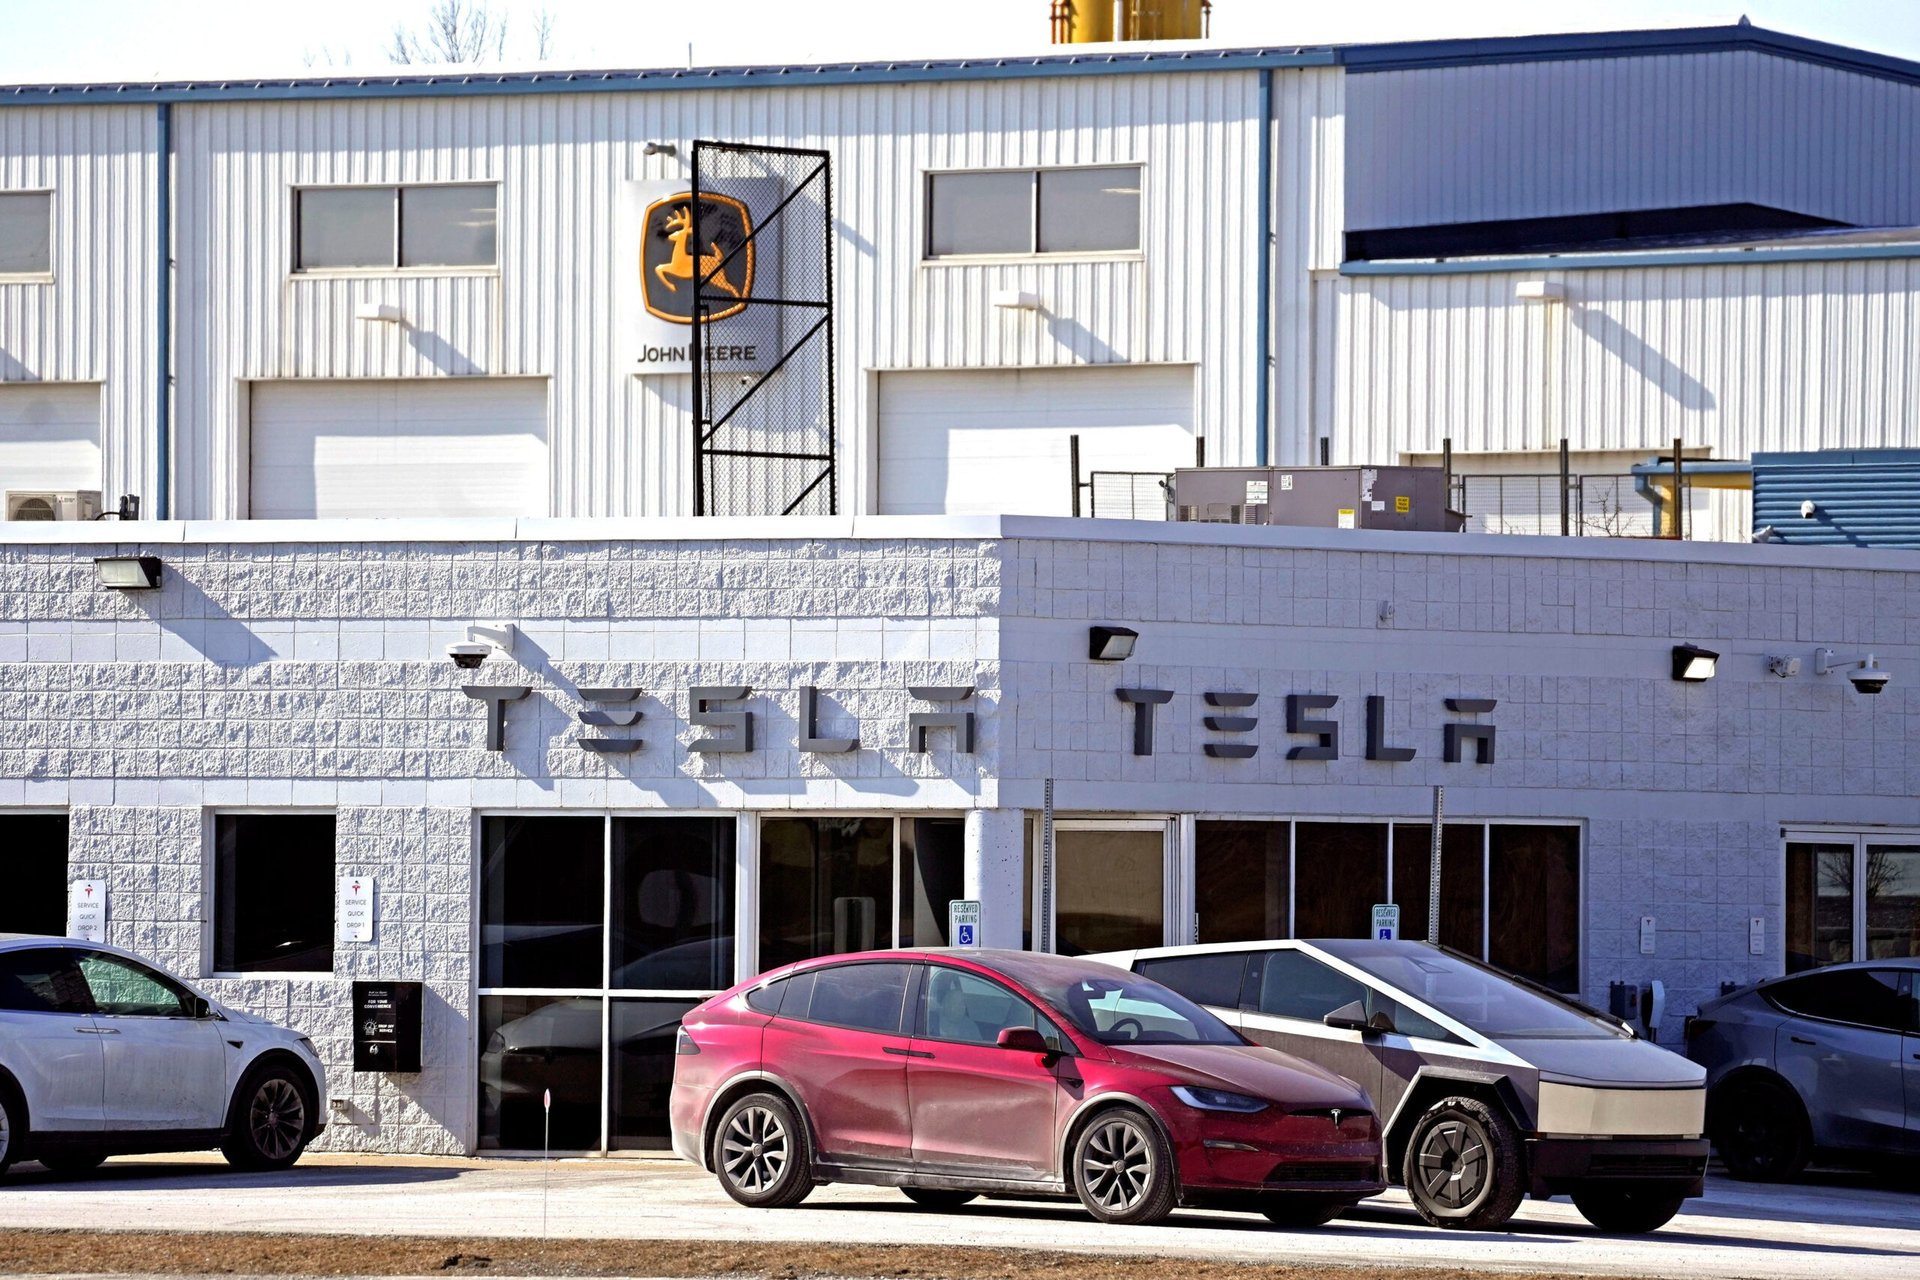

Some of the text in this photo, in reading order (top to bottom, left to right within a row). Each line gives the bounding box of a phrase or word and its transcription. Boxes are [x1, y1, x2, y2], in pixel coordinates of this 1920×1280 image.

[637, 344, 685, 362] JOHN
[461, 685, 975, 754] TESLA
[1115, 688, 1498, 765] TESLA
[953, 904, 978, 913] RESERVED
[954, 914, 978, 923] PARKING
